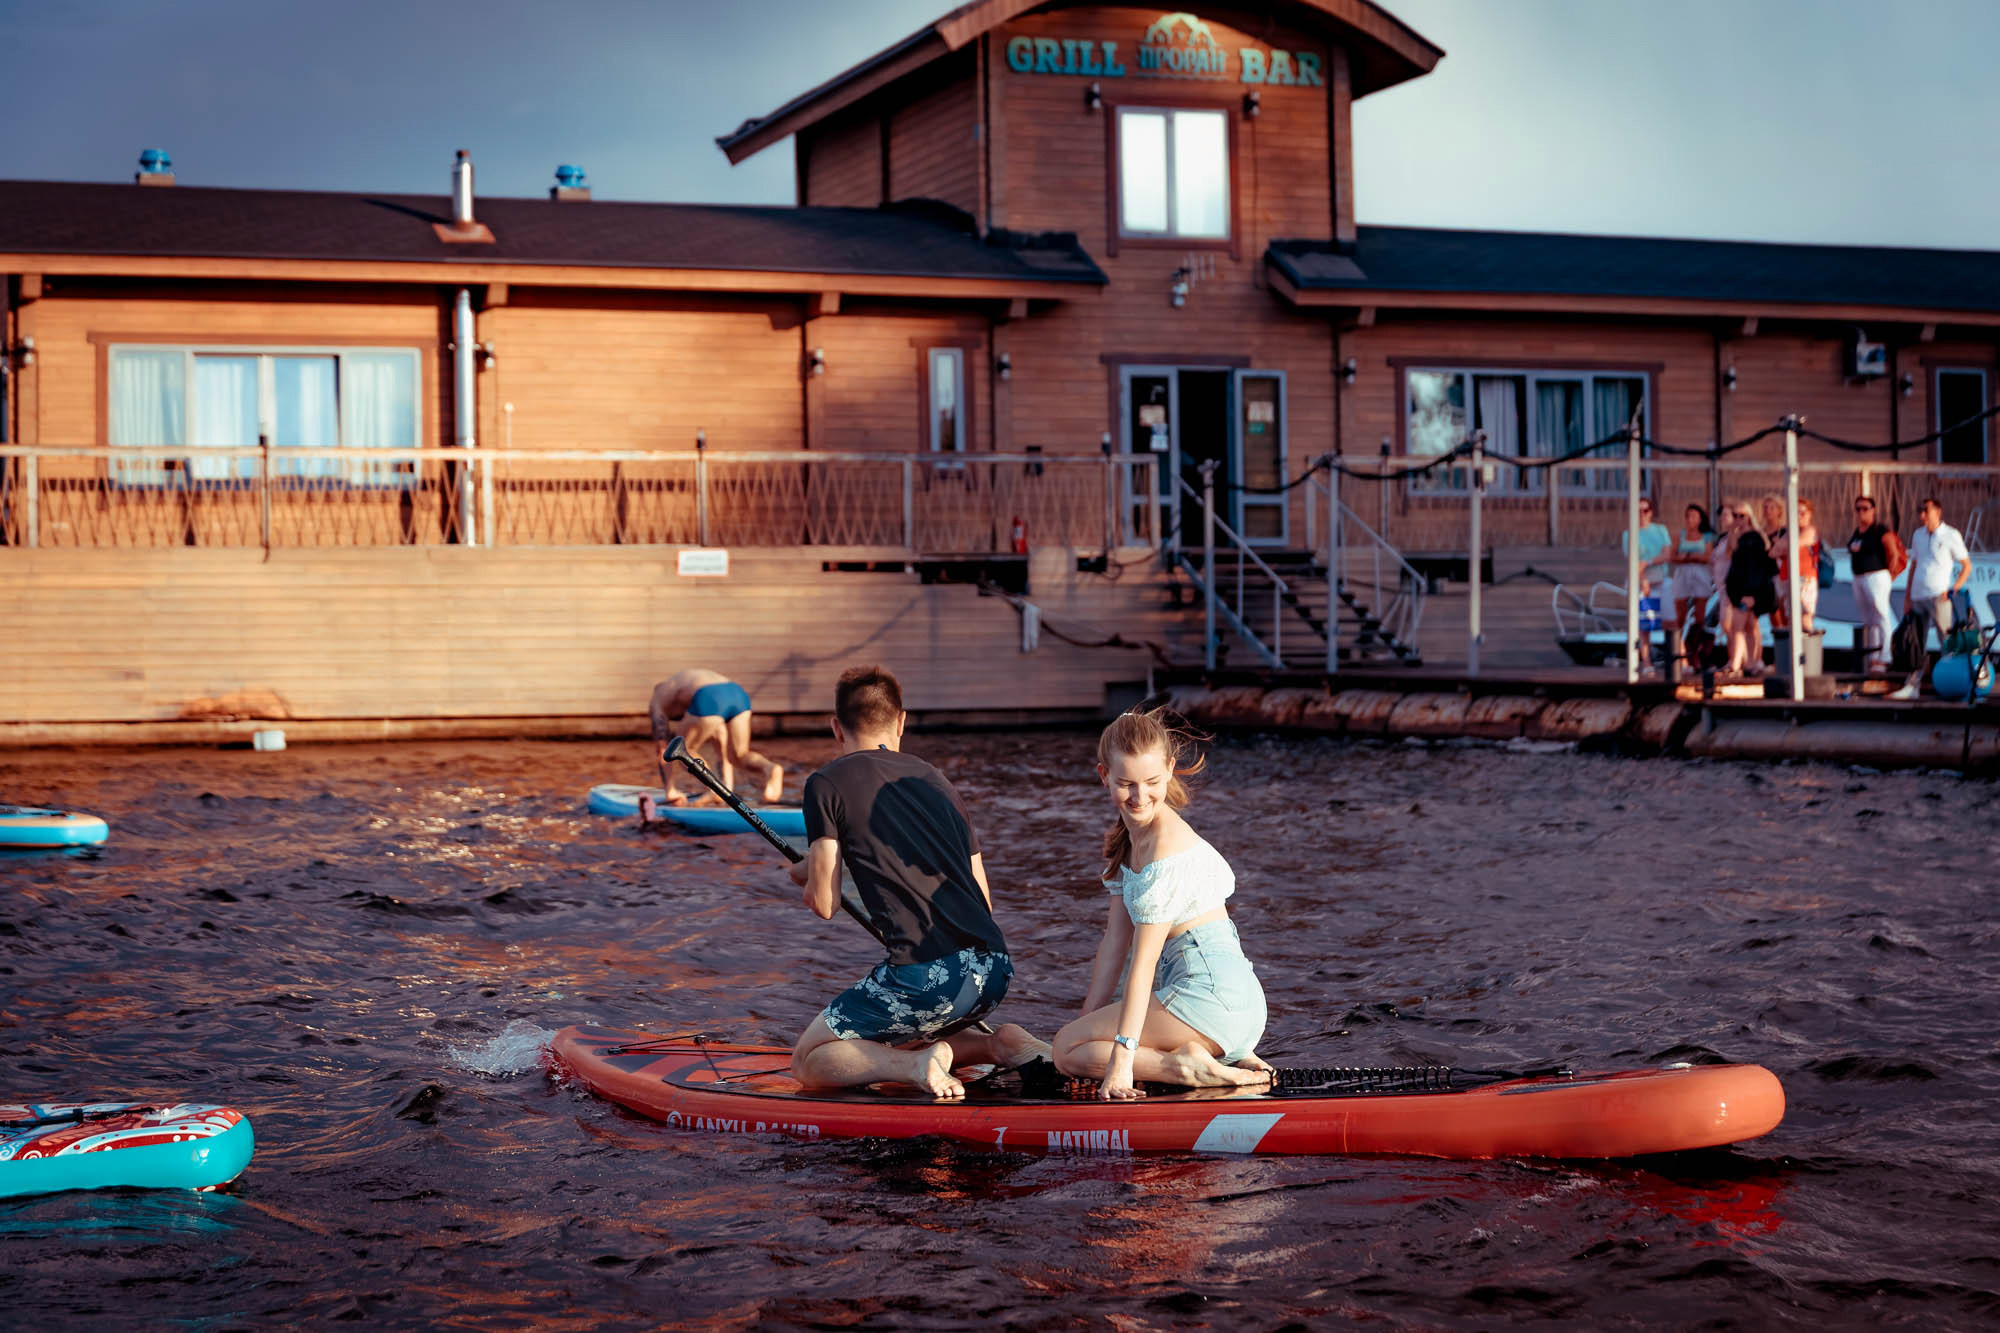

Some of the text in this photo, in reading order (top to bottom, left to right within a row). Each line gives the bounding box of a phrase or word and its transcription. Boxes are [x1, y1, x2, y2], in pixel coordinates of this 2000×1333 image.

[1007, 36, 1126, 77] GRILL
[1239, 47, 1323, 87] BAR
[737, 801, 788, 849] SKATINGER
[1047, 1129, 1134, 1152] NATURAL
